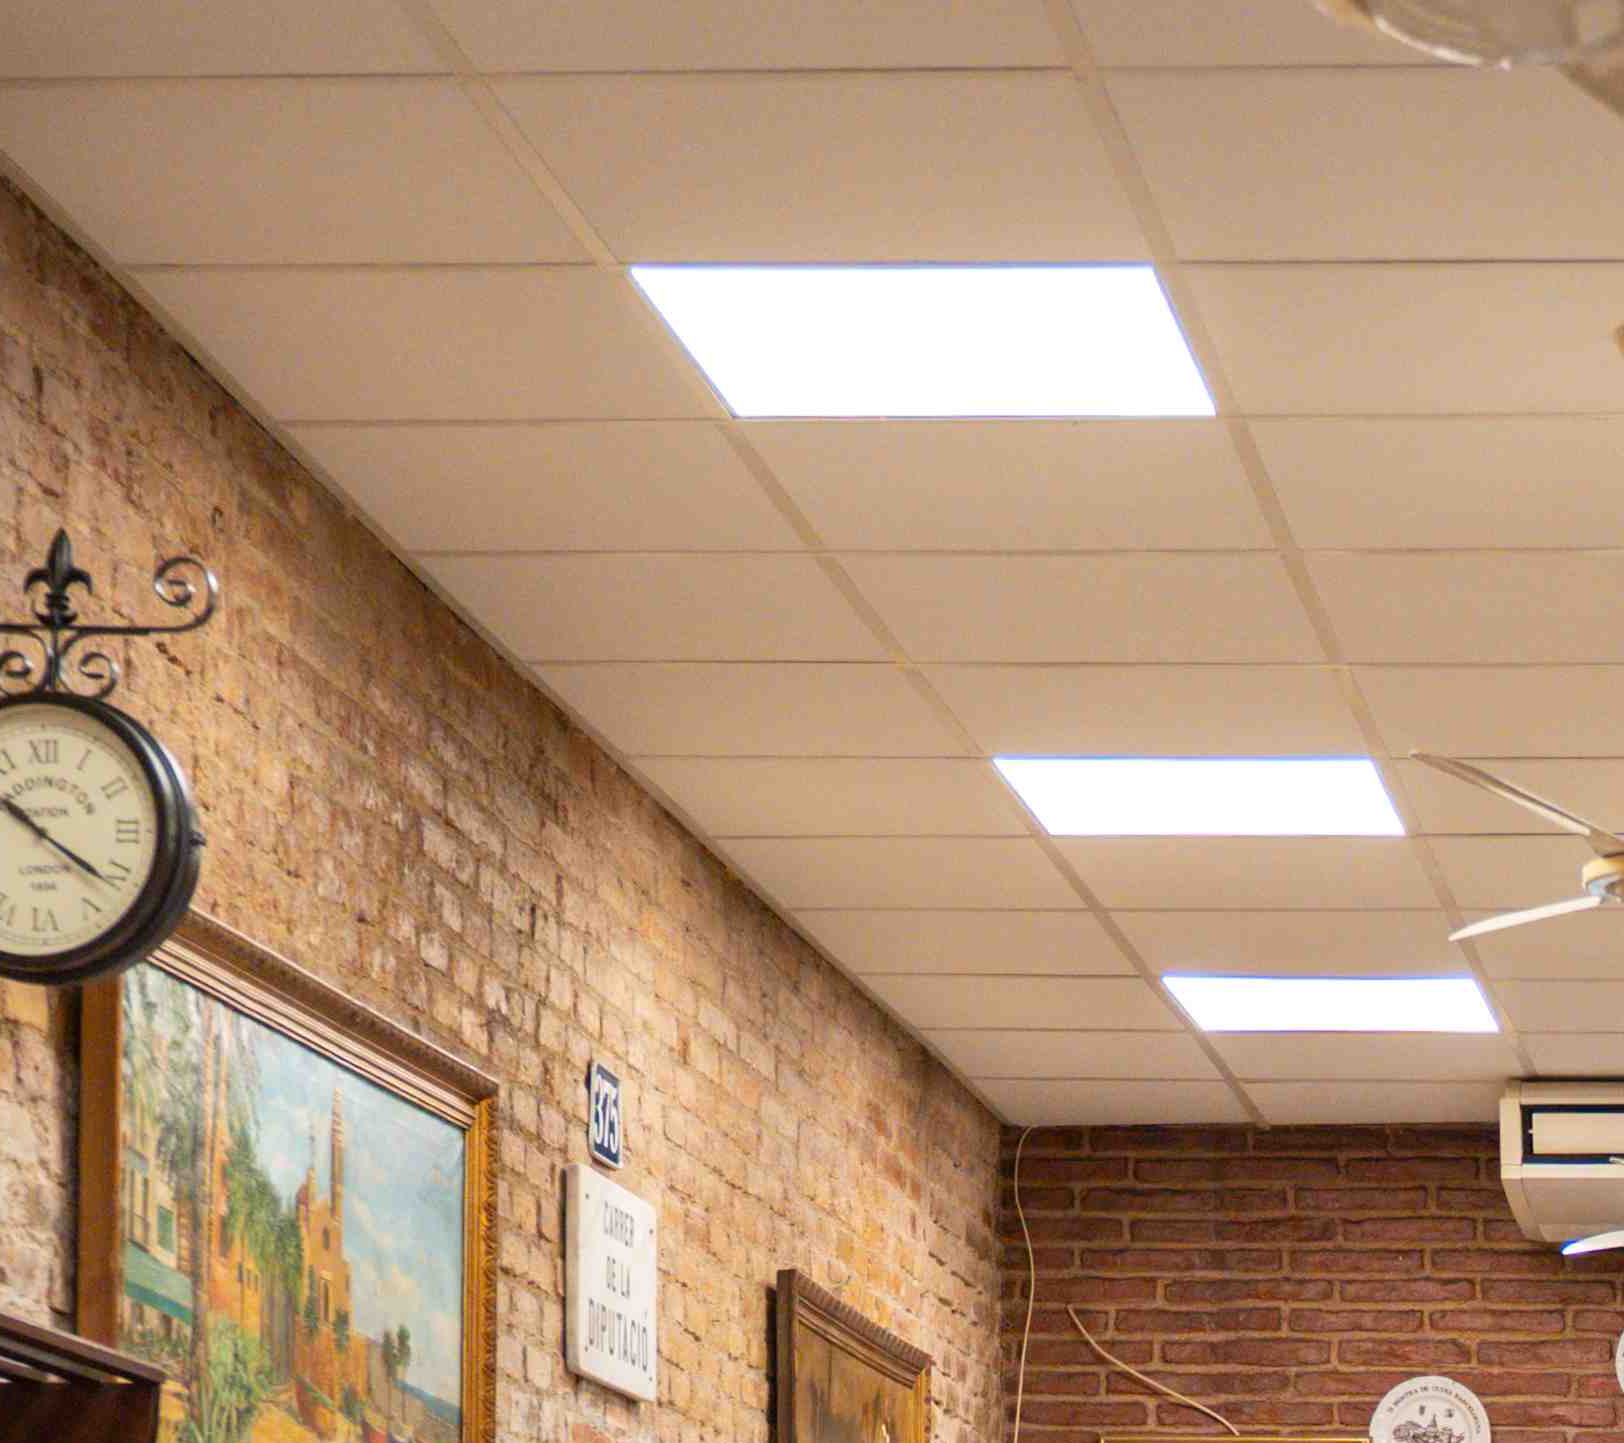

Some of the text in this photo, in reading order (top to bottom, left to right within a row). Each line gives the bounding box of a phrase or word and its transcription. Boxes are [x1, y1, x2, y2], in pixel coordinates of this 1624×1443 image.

[28, 739, 59, 764] XII
[2, 776, 97, 816] ADDINGTON
[116, 819, 139, 844] III
[593, 1074, 620, 1155] 375
[602, 1200, 635, 1249] CARRER
[605, 1255, 632, 1300] DE LA
[587, 1295, 649, 1372] DIPUTACIÓ
